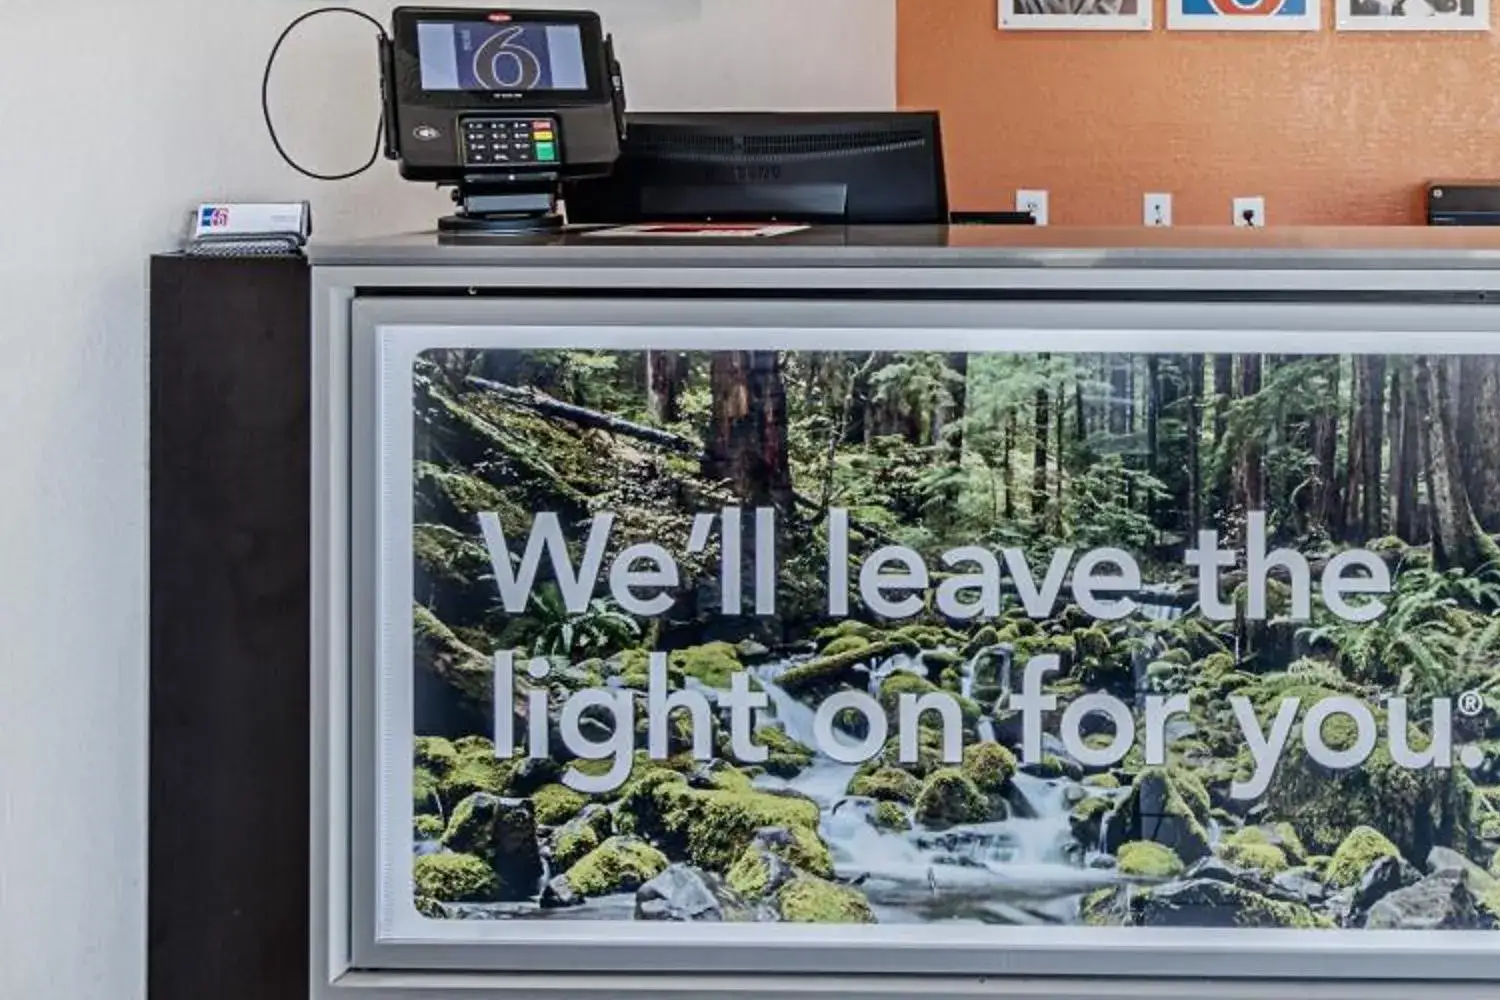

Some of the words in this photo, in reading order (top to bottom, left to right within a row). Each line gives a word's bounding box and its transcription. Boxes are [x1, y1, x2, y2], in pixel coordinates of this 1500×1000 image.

[472, 25, 541, 90] 6
[828, 507, 1142, 622] leave
[1185, 510, 1392, 623] the
[494, 651, 770, 793] light
[813, 689, 963, 764] on
[1010, 654, 1191, 768] for
